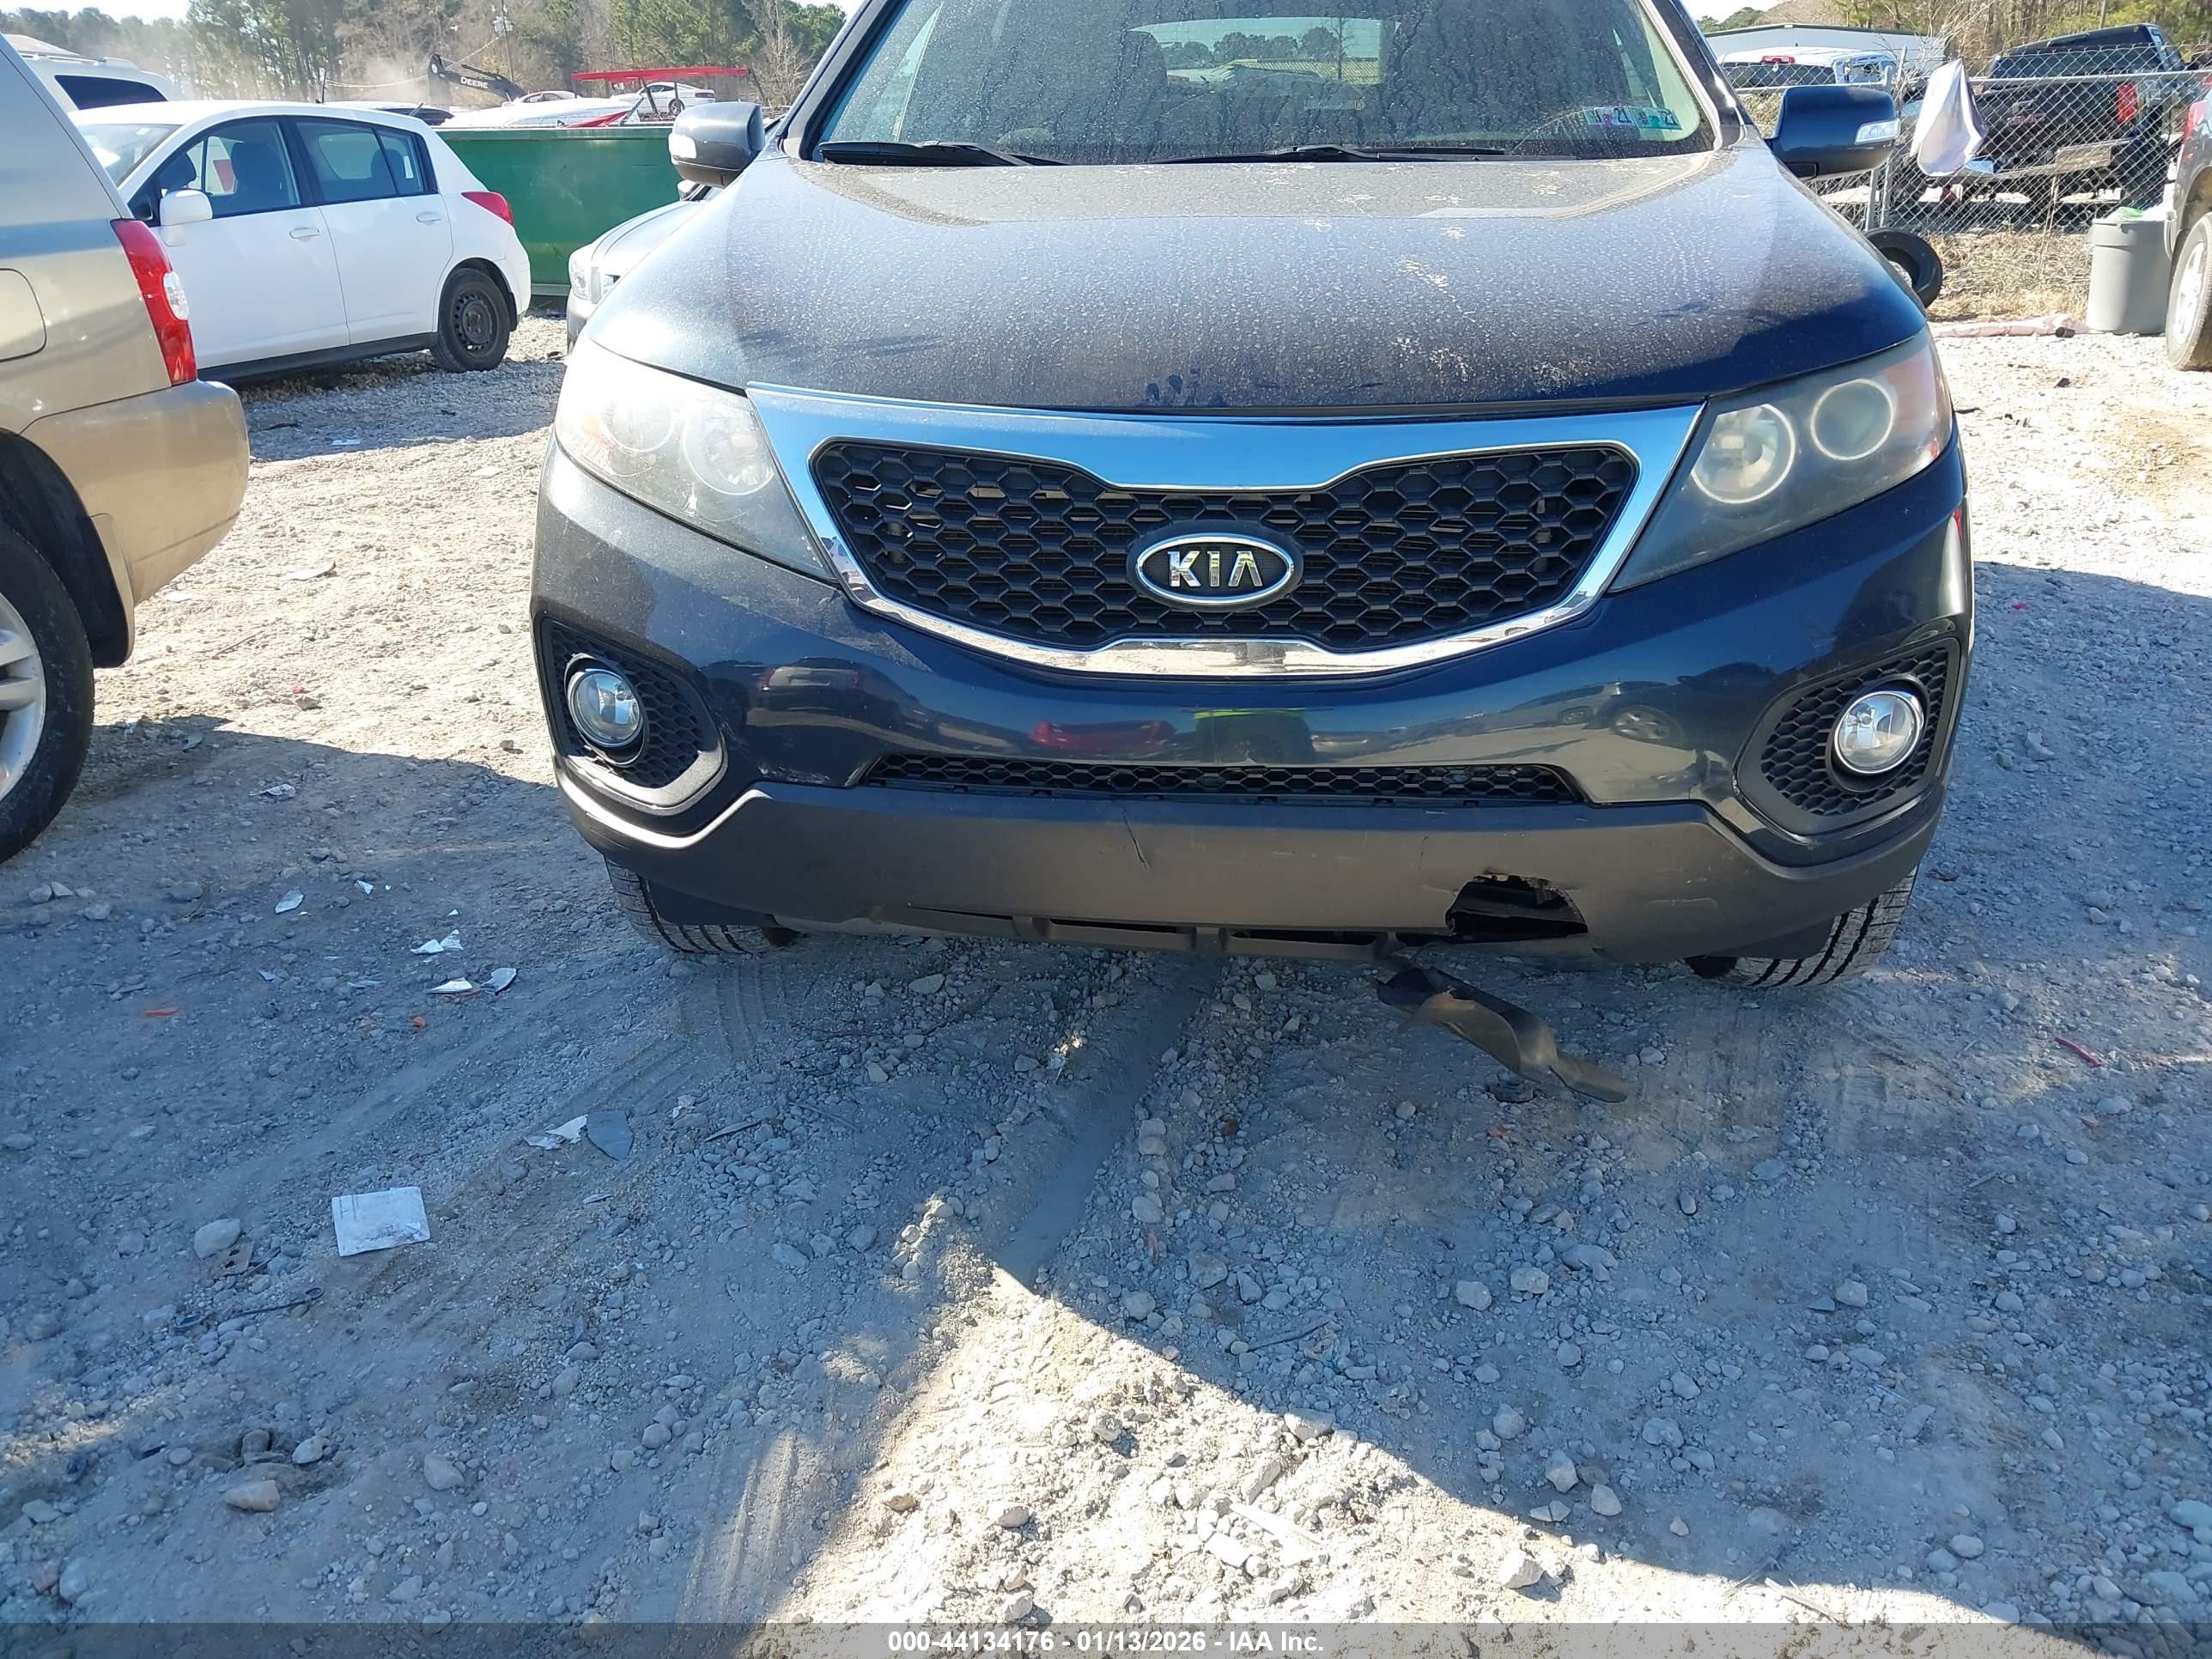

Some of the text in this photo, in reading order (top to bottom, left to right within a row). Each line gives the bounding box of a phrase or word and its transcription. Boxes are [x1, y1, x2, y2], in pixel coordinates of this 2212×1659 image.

[460, 76, 489, 89] DEERE
[1613, 107, 1632, 124] 21
[1167, 550, 1264, 587] KIA
